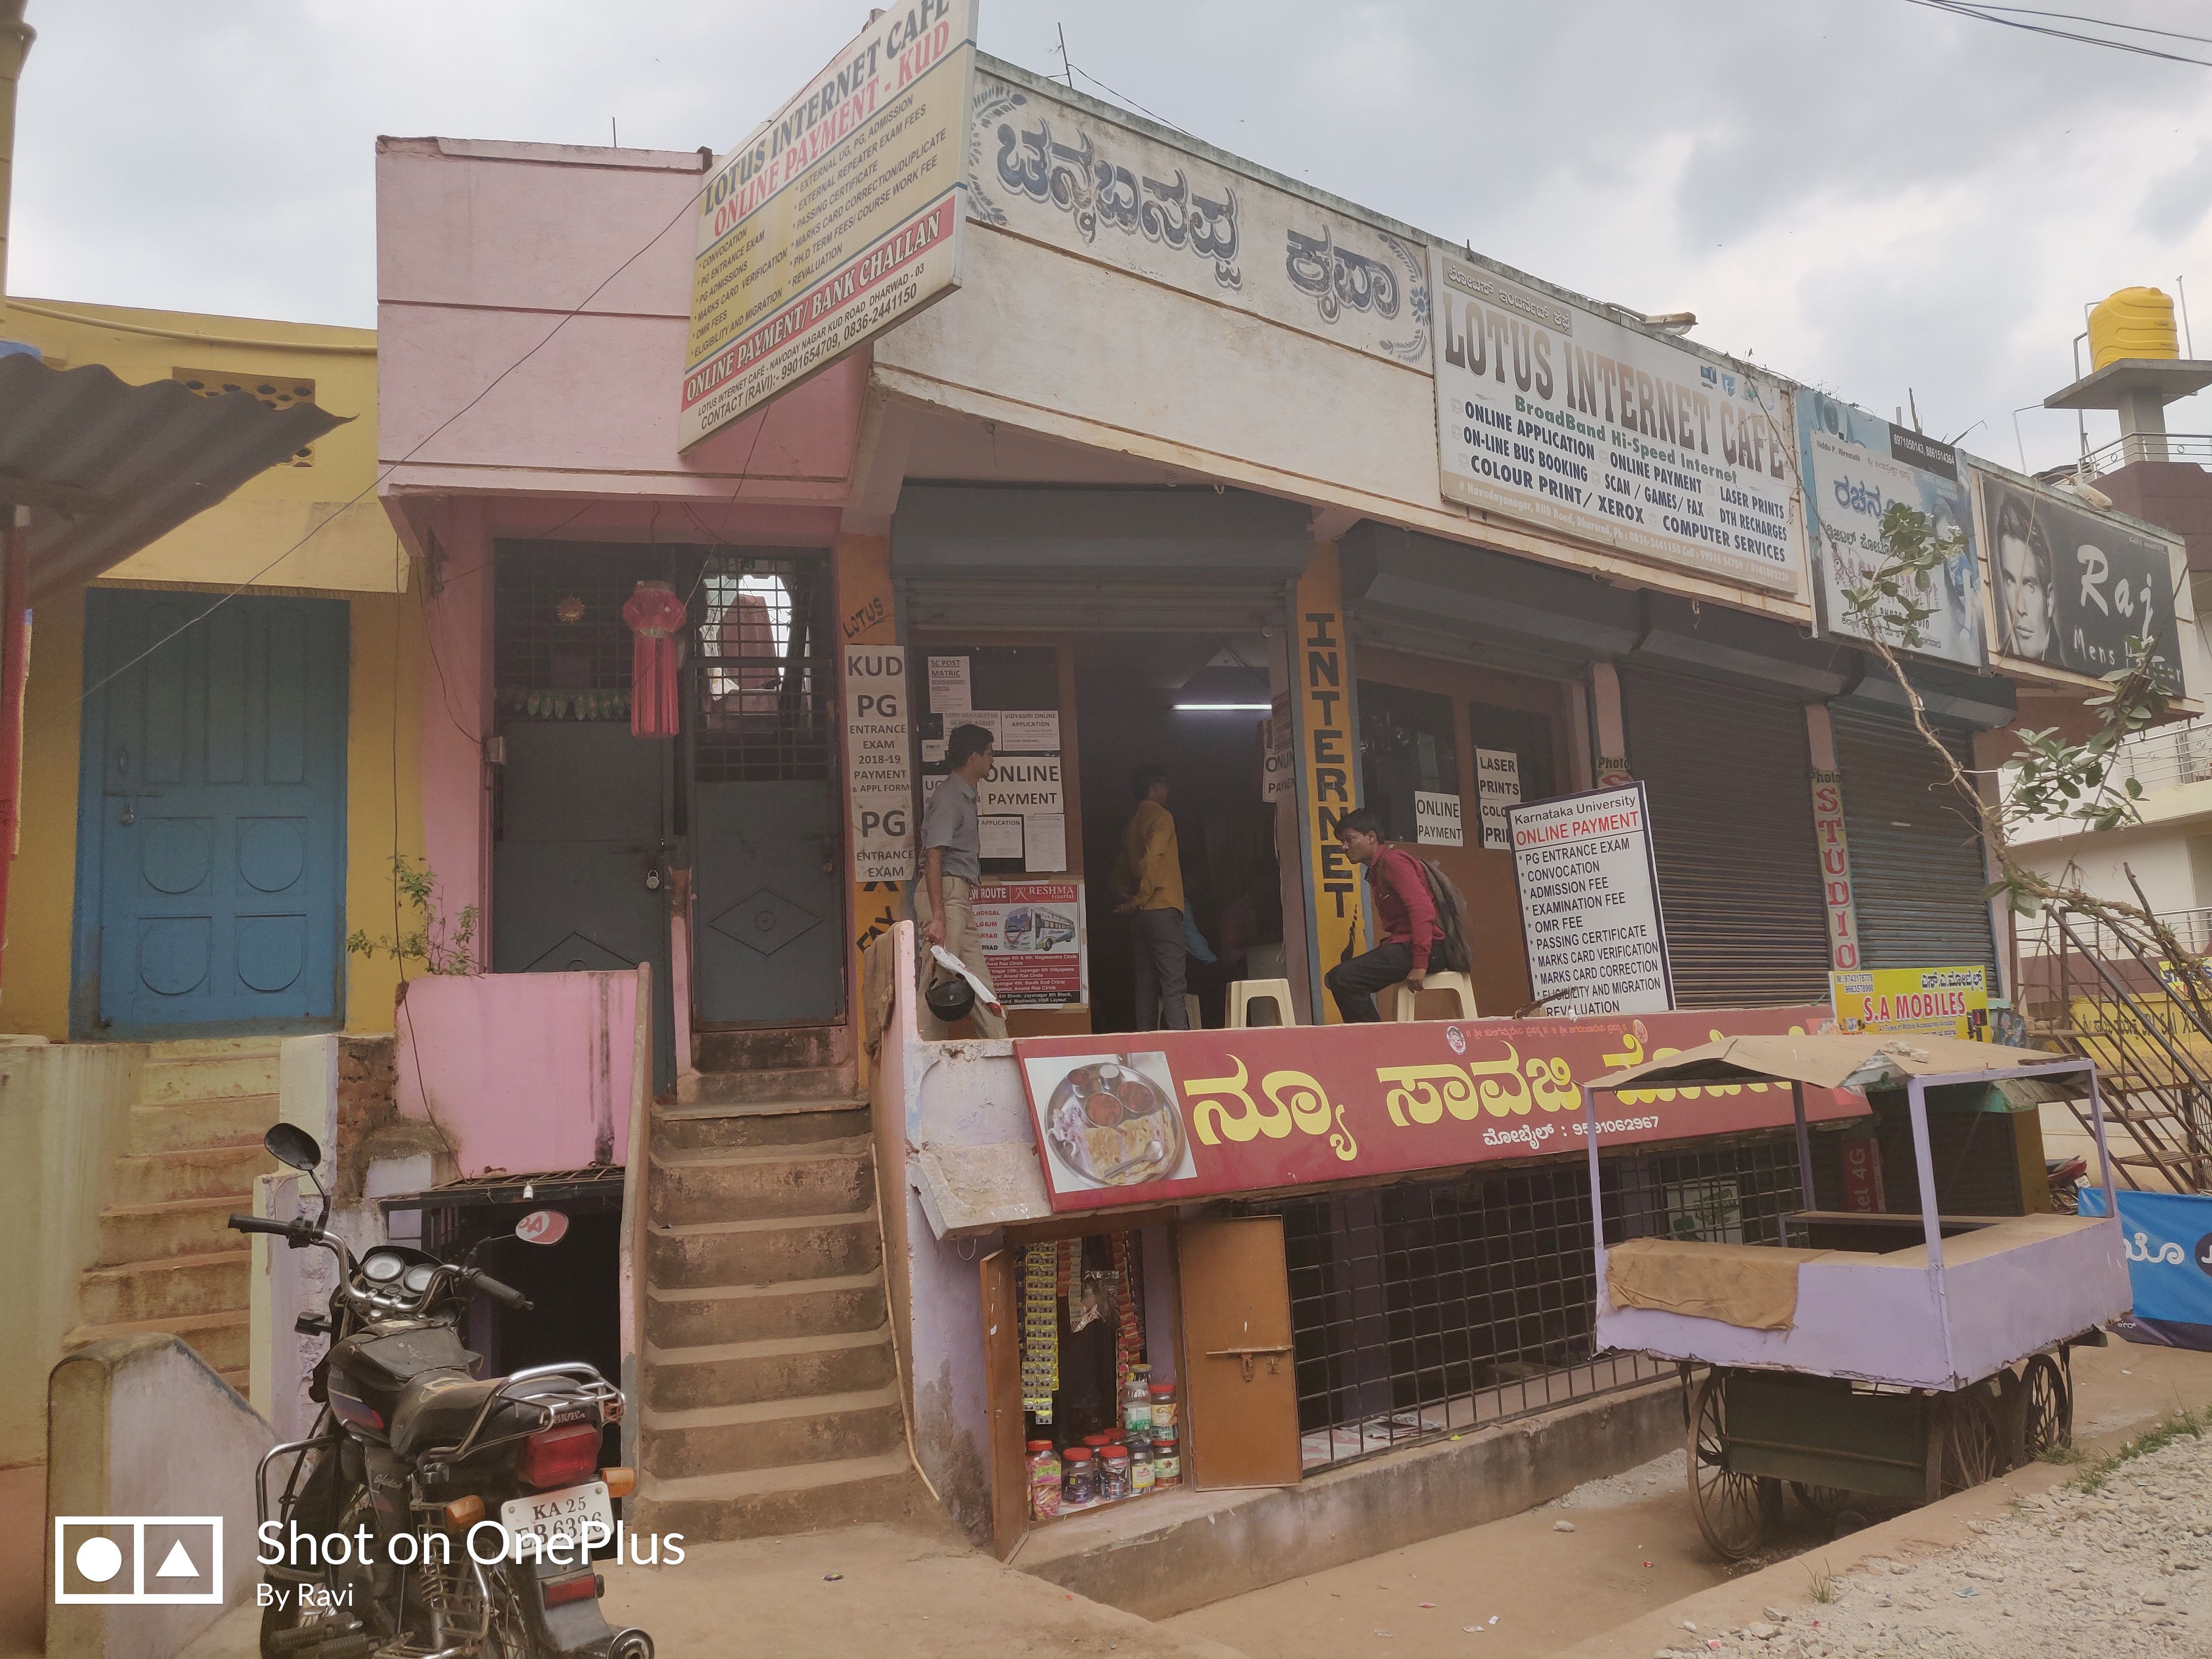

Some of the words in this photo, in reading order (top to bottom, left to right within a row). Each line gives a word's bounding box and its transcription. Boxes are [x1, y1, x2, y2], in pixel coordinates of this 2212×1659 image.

[704, 139, 766, 216] LOTUS
[771, 36, 881, 160] INTERNET
[715, 160, 779, 237] ONLINE
[784, 75, 878, 182] PAYMENT
[897, 21, 949, 90] KUD
[799, 176, 835, 211] EXTERNAL
[838, 142, 877, 181] REPEATER
[880, 122, 902, 148] EXAM
[904, 104, 926, 130] FEES
[800, 157, 837, 192] EXTERNAL
[868, 94, 913, 139] ADMISSION
[797, 201, 828, 230] PASSING
[830, 160, 878, 204] CERTIFICATE
[812, 232, 832, 253] TERM
[857, 189, 890, 221] COURSE
[893, 169, 918, 195] WORK
[921, 155, 937, 176] FEE
[795, 222, 820, 249] MARKS
[823, 206, 843, 228] CARD
[700, 275, 709, 287] PG
[711, 247, 744, 279] ENTRANCE
[746, 230, 765, 253] EXAM
[702, 227, 747, 269] CONVOCATION
[793, 243, 842, 287] REVALUATION
[697, 300, 719, 322] MARKS
[721, 285, 739, 304] CARD
[742, 247, 787, 289] VERIFICATION
[699, 292, 708, 304] PG
[709, 261, 747, 296] ADMISSIONS
[687, 351, 734, 402] ONLINE
[810, 268, 855, 321] BANK
[859, 209, 941, 287] CHALLAN
[695, 326, 730, 357] ELIGIBILITY
[730, 315, 744, 333] AND
[745, 287, 782, 322] MIGRATION
[697, 326, 709, 339] OMR
[711, 310, 727, 329] FEES
[698, 397, 717, 417] LOTUS
[718, 377, 747, 405] INTERNET
[770, 343, 800, 372] NAVODAY
[802, 326, 826, 350] NAGAR
[828, 316, 842, 334] KUD
[844, 301, 866, 323] ROAD
[869, 274, 908, 306] DHARWAD
[915, 263, 924, 277] 03
[1443, 291, 1553, 401] LOTUS
[1563, 340, 1711, 456] INTERNET
[1720, 400, 1785, 480] CAFE
[701, 392, 743, 430] CONTACT
[1515, 394, 1606, 442] BroadBand
[1611, 430, 1675, 466] Hi-Speed
[1681, 453, 1737, 483] Internet
[1465, 401, 1512, 433] ONLINE
[1517, 419, 1595, 461] APPLICATION
[1611, 452, 1650, 479] ONLINE
[1654, 466, 1702, 494] PAYMENT
[1720, 486, 1748, 508] LASER
[1752, 496, 1784, 519] PRINTS
[1464, 427, 1509, 457] ON-LINE
[1514, 443, 1535, 464] BUS
[1539, 450, 1587, 482] BOOKING
[1605, 473, 1630, 496] SCAN
[1687, 498, 1705, 517] FAX
[1720, 507, 1737, 527] DTH
[1740, 514, 1787, 541] RECHARGES
[1471, 455, 1534, 490] COLOUR
[1598, 494, 1644, 524] XEROX
[1663, 515, 1730, 548] COMPUTER
[1734, 535, 1786, 563] SERVICES
[2077, 544, 2153, 640] Raj
[843, 597, 883, 638] LOTUS
[2074, 626, 2115, 665] Mens
[848, 656, 902, 676] KUD
[857, 695, 897, 718] PG
[850, 724, 906, 734] ENTRANCE
[863, 740, 894, 749] EXAM
[858, 755, 901, 764] 2018-19
[1306, 613, 1354, 918] INTERNET
[1480, 756, 1515, 773] LASER
[854, 770, 906, 780] PAYMENT
[860, 784, 882, 793] APPL
[884, 784, 910, 792] FORM
[1479, 780, 1519, 795] PRINTS
[988, 793, 1057, 805] PAYMENT
[1417, 799, 1459, 817] ONLINE
[1515, 807, 1573, 825] Karnataka
[1576, 795, 1636, 814] University
[861, 810, 906, 838] PG
[1419, 825, 1461, 840] PAYMENT
[1516, 823, 1569, 846] ONLINE
[1573, 811, 1638, 837] PAYMENT
[856, 850, 914, 861] ENTRANCE
[1526, 853, 1539, 865] PG
[1543, 843, 1597, 863] ENTRANCE
[1600, 838, 1630, 853] EXAM
[868, 867, 904, 878] EXAM
[1527, 860, 1600, 882] CONVOCATION
[1815, 787, 1858, 969] STUDIO
[981, 888, 1006, 899] ROUTE
[1029, 887, 1074, 895] RESHMA
[1530, 880, 1586, 899] ADMISSION
[1589, 877, 1609, 890] FEE
[1532, 895, 1602, 916] EXAMINATION
[1605, 892, 1626, 906] FEE
[1535, 920, 1560, 933] OMR
[1562, 915, 1583, 929] FEE
[1537, 934, 1579, 950] PASSING
[1582, 925, 1647, 944] CERTIFICATE
[1538, 953, 1569, 967] MARKS
[1571, 950, 1595, 963] CARD
[1597, 941, 1659, 960] VERIFICATION
[1540, 970, 1571, 985] MARKS
[1573, 967, 1597, 981] CARD
[1599, 959, 1658, 978] CORRECTION
[1592, 983, 1610, 997] AND
[1612, 977, 1660, 995] MIGRATION
[1895, 991, 1966, 1019] MOBILES
[1376, 1041, 1581, 1127] ಸಾವಜಿ
[532, 1501, 563, 1521] KA
[566, 1495, 586, 1513] 25
